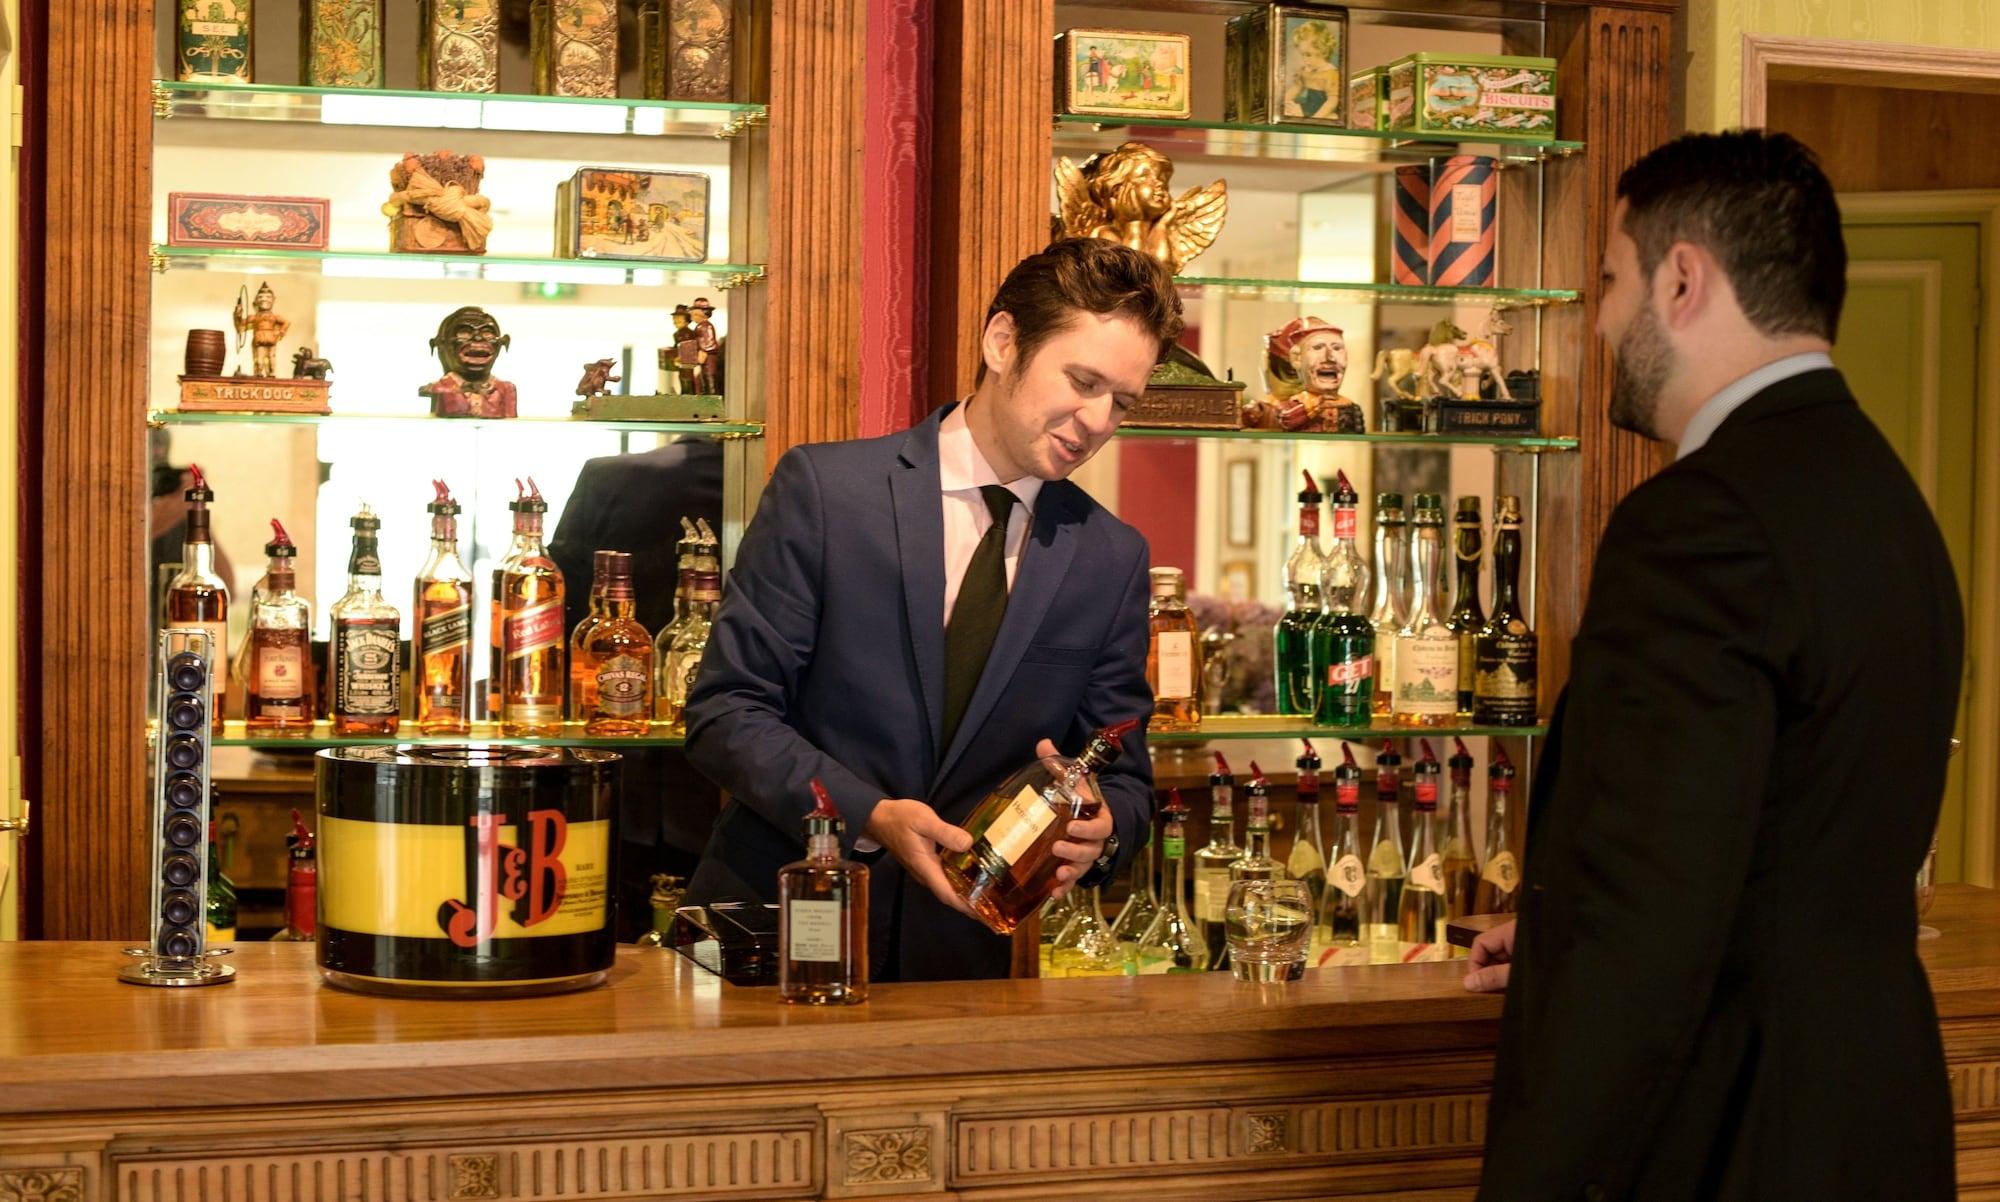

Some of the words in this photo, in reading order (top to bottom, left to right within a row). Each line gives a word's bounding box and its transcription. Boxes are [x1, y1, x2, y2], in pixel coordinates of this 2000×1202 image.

[1484, 94, 1551, 108] BISCUITS
[215, 386, 260, 400] TRICK
[262, 387, 294, 400] DOG
[1168, 397, 1235, 416] WHALE
[1456, 411, 1489, 425] TRICK
[1492, 412, 1521, 425] PONY
[597, 670, 625, 683] CHIVAS
[1331, 657, 1370, 683] GET
[448, 809, 567, 948] J&B
